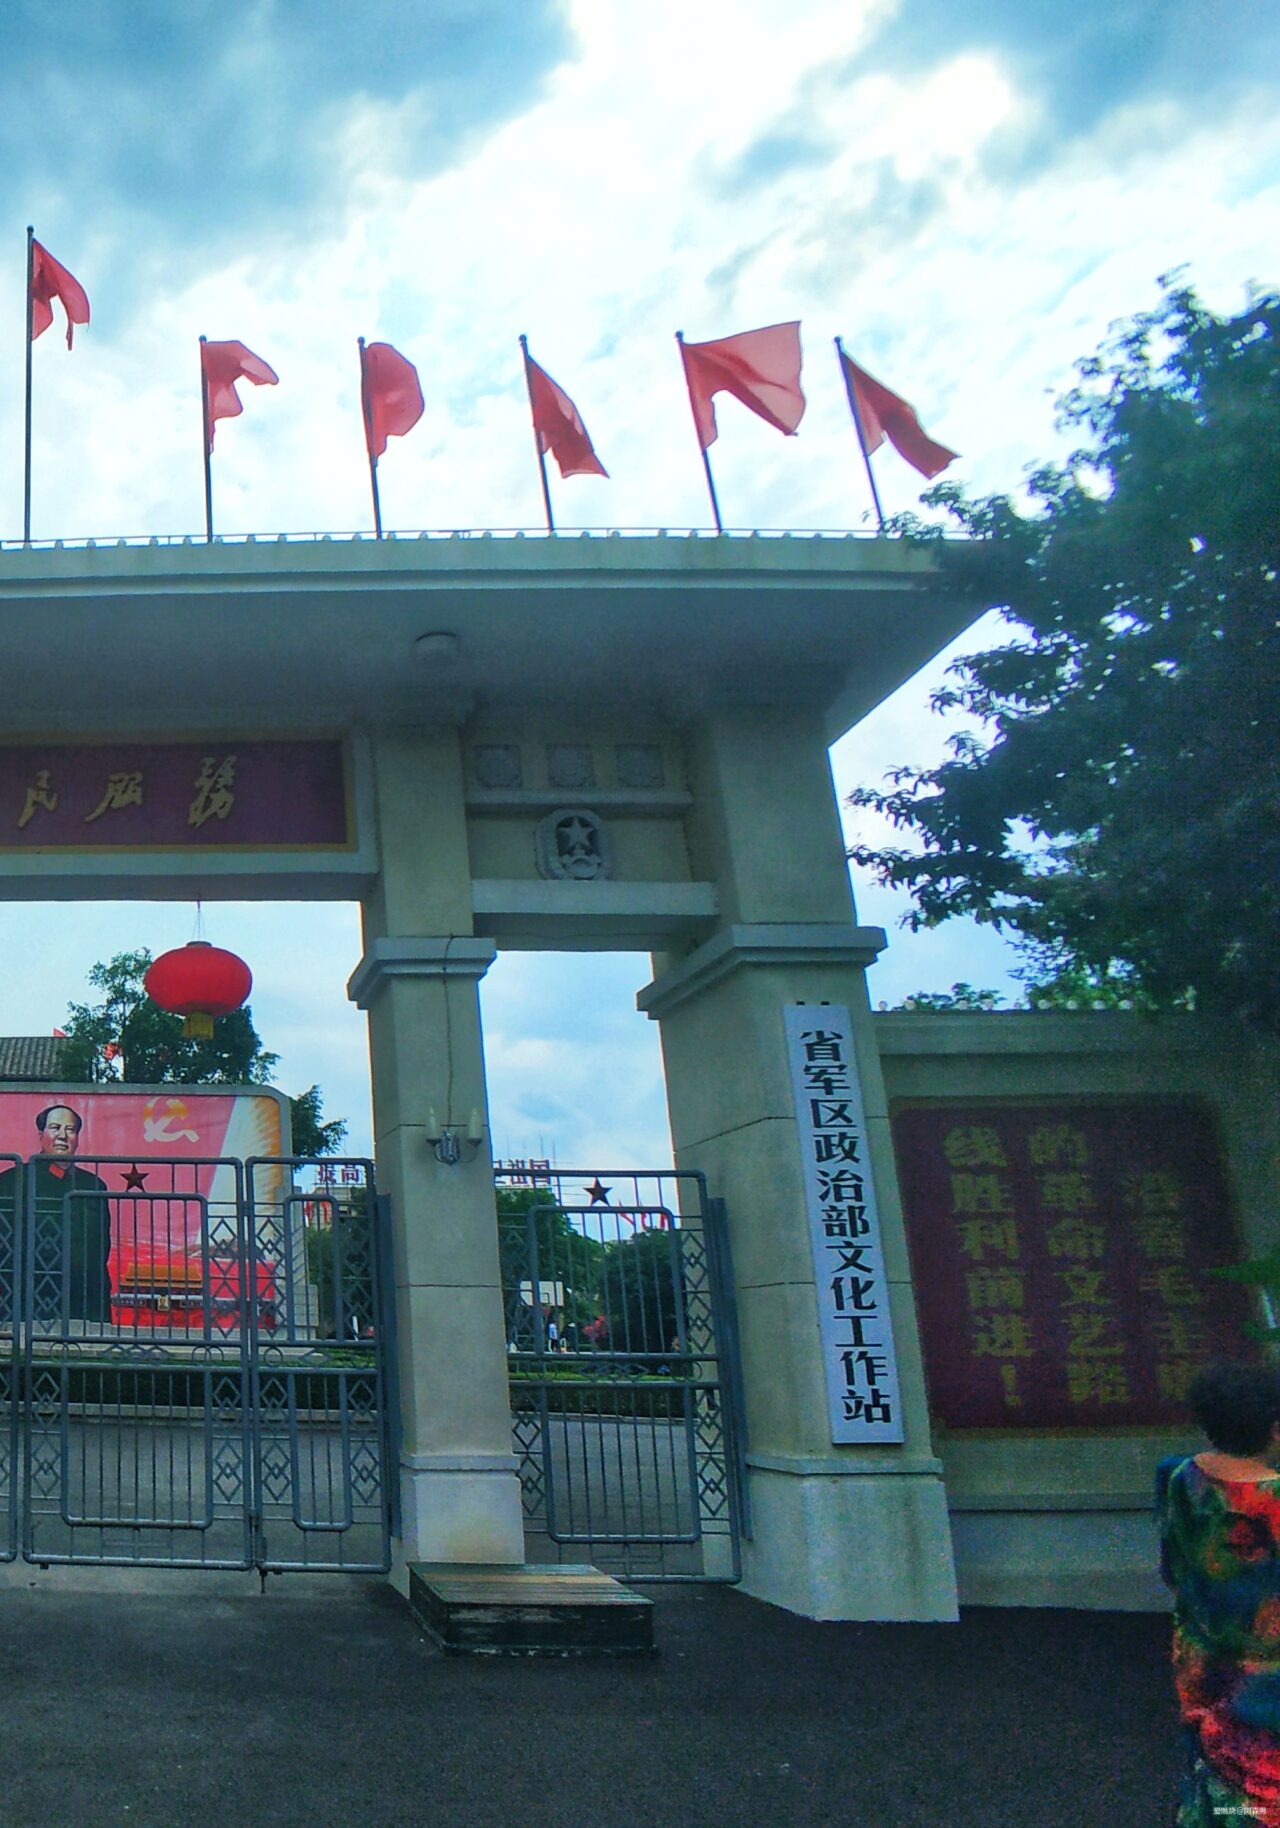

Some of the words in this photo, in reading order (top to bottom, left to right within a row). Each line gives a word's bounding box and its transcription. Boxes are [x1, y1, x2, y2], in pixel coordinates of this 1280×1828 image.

[800, 1030, 891, 1423] 省军区政治部文化工作站
